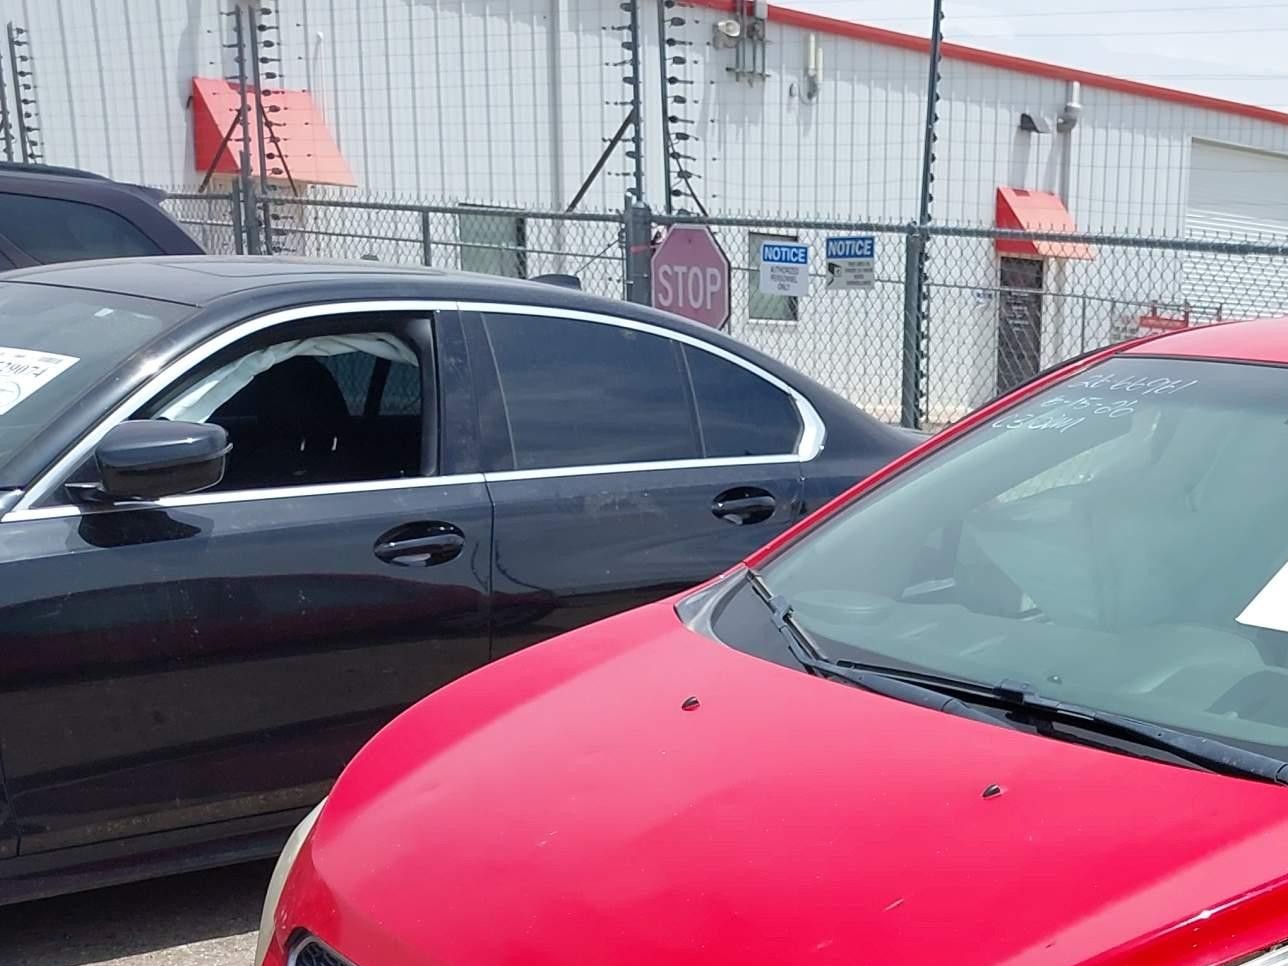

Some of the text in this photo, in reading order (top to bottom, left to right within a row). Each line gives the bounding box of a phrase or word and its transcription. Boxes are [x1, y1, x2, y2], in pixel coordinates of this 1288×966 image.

[763, 246, 806, 262] NOTICE
[828, 240, 872, 256] NOTICE
[658, 264, 721, 309] STOP
